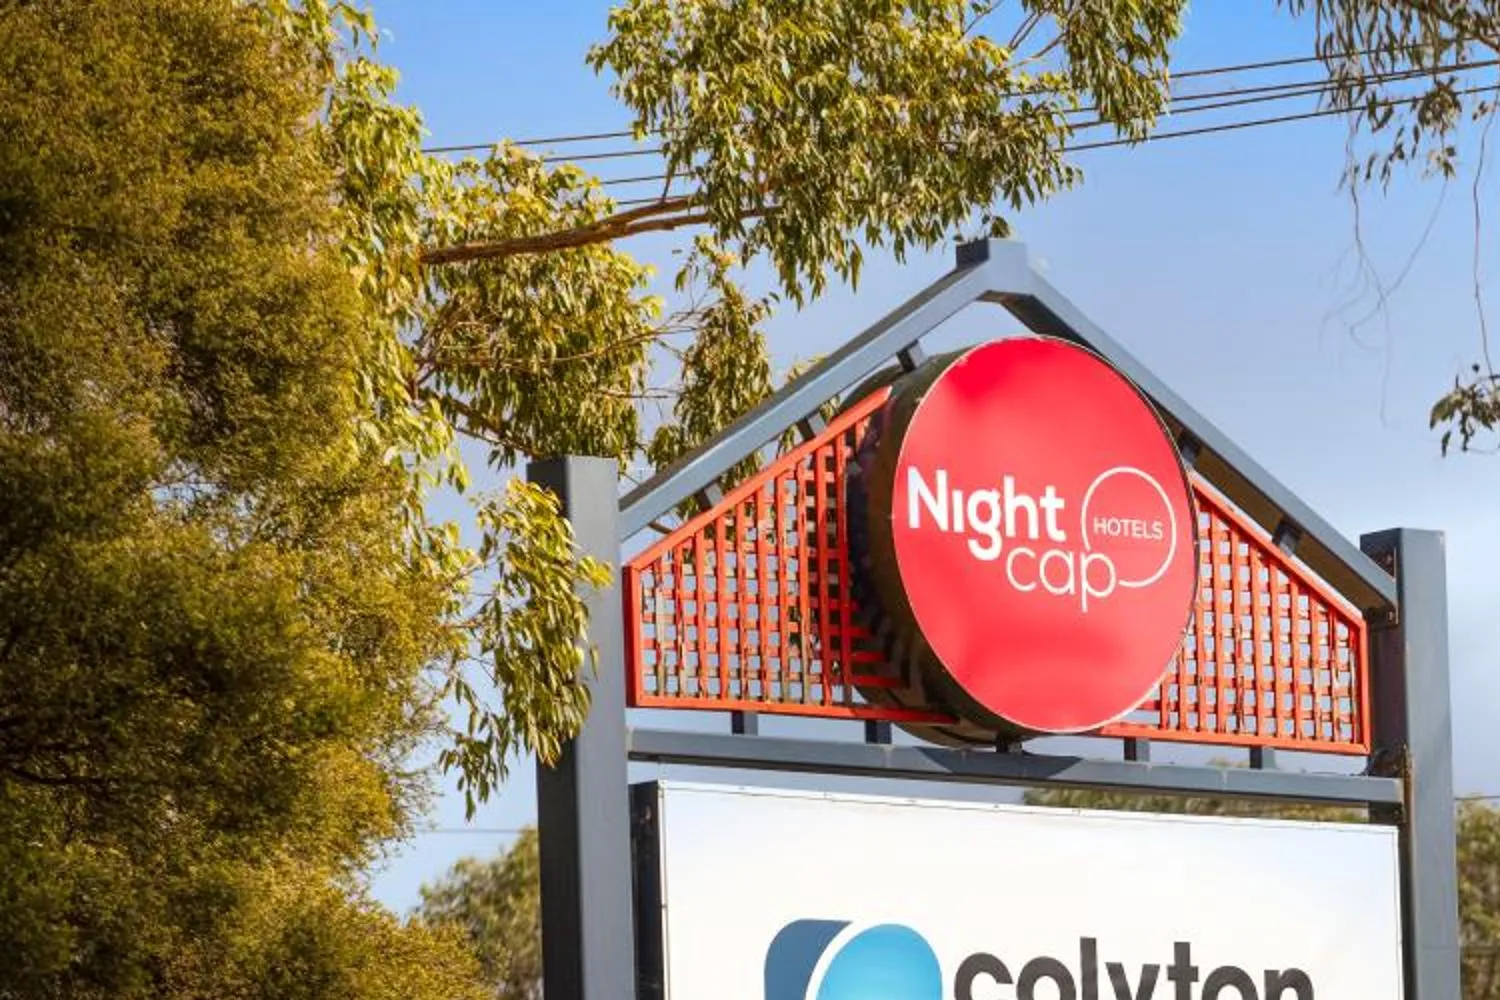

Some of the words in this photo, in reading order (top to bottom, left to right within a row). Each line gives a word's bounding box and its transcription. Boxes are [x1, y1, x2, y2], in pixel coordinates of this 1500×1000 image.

[907, 466, 1067, 561] Night
[1094, 517, 1164, 540] HOTELS
[1005, 547, 1117, 613] cap
